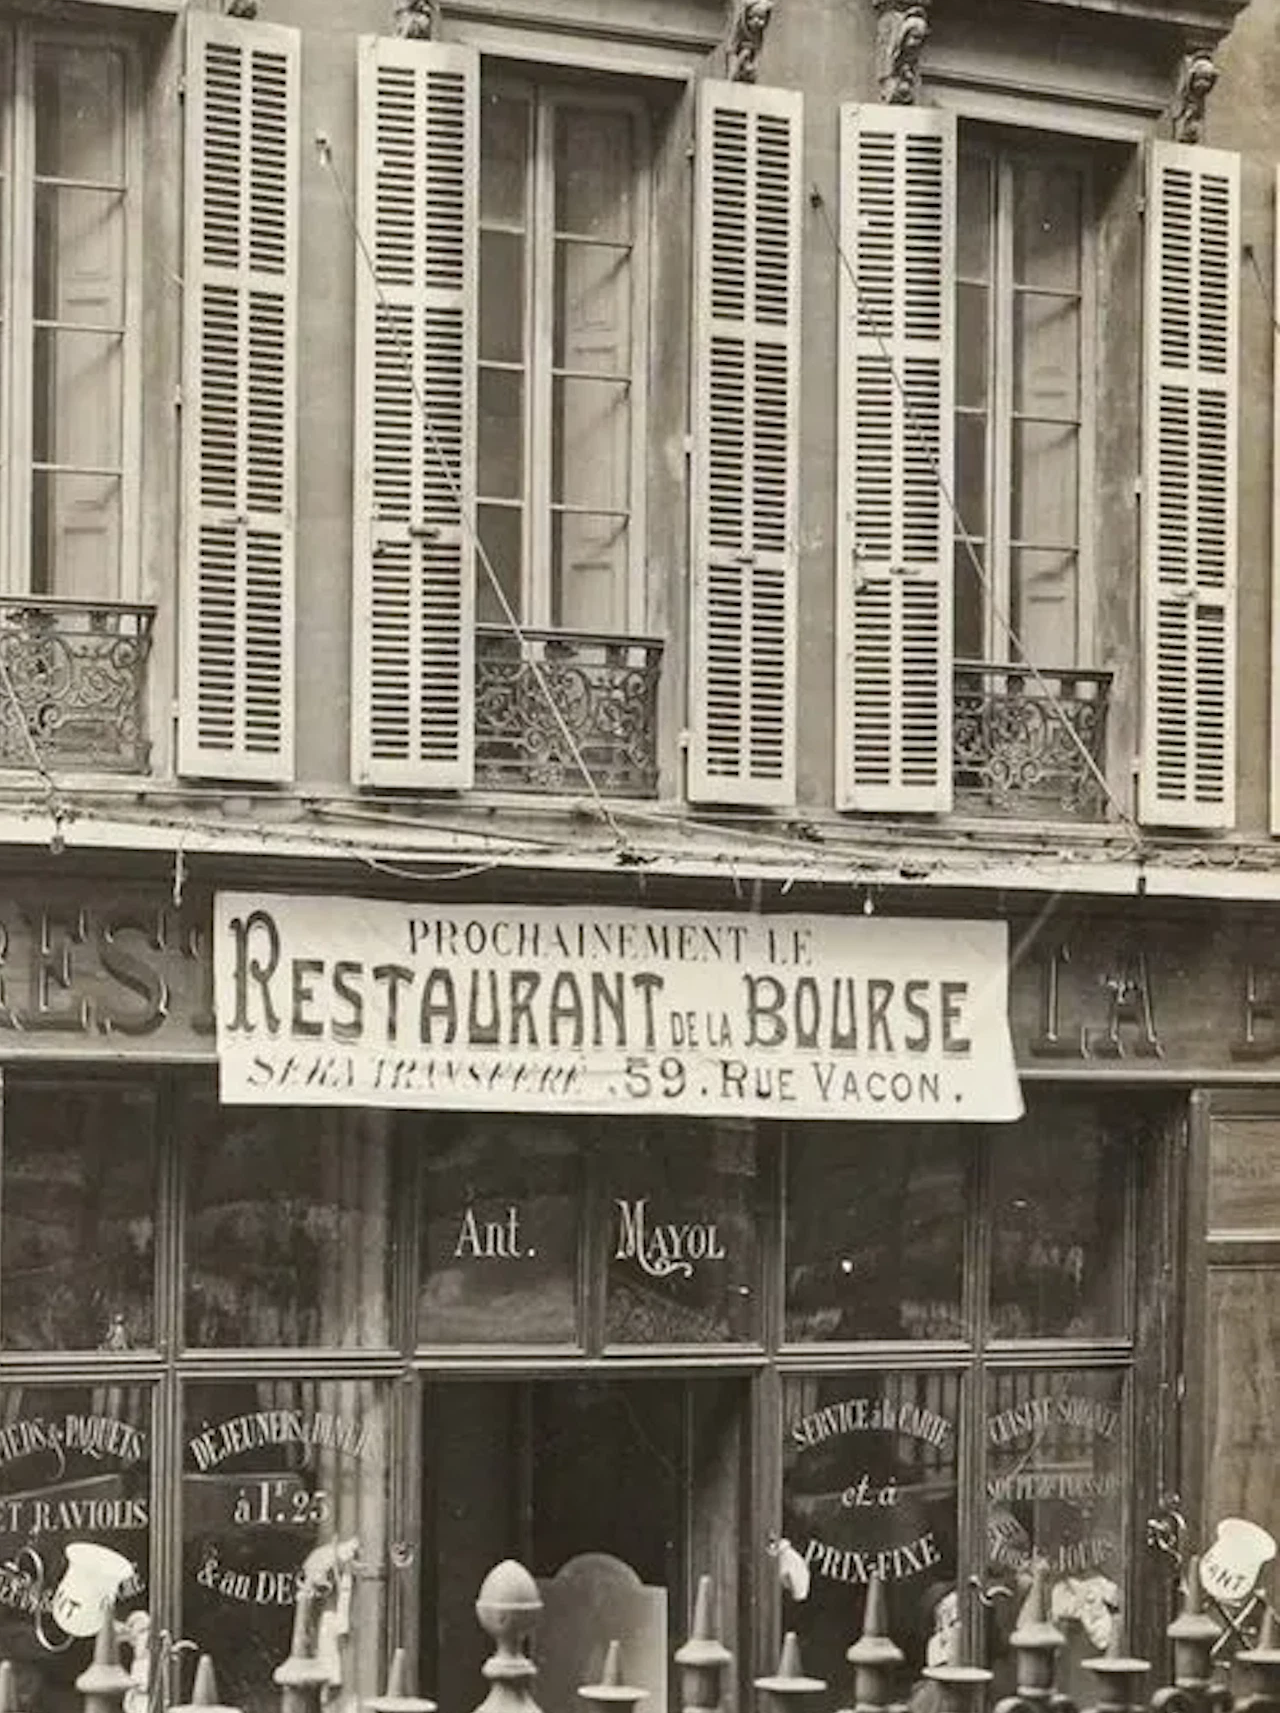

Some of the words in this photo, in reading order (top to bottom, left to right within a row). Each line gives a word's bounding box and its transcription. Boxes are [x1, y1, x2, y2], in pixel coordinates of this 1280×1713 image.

[408, 918, 746, 963] PROCHAINEMENT
[768, 930, 813, 964] LE
[226, 910, 665, 1048] RESTAURANT
[670, 1011, 697, 1047] DE
[706, 1011, 732, 1047] LA
[744, 974, 970, 1053] BOURSE
[720, 1059, 797, 1102] RUE
[453, 1205, 537, 1260] Ant.
[792, 1398, 868, 1452] SERVICE
[28, 1496, 149, 1538] RAVIOLIS
